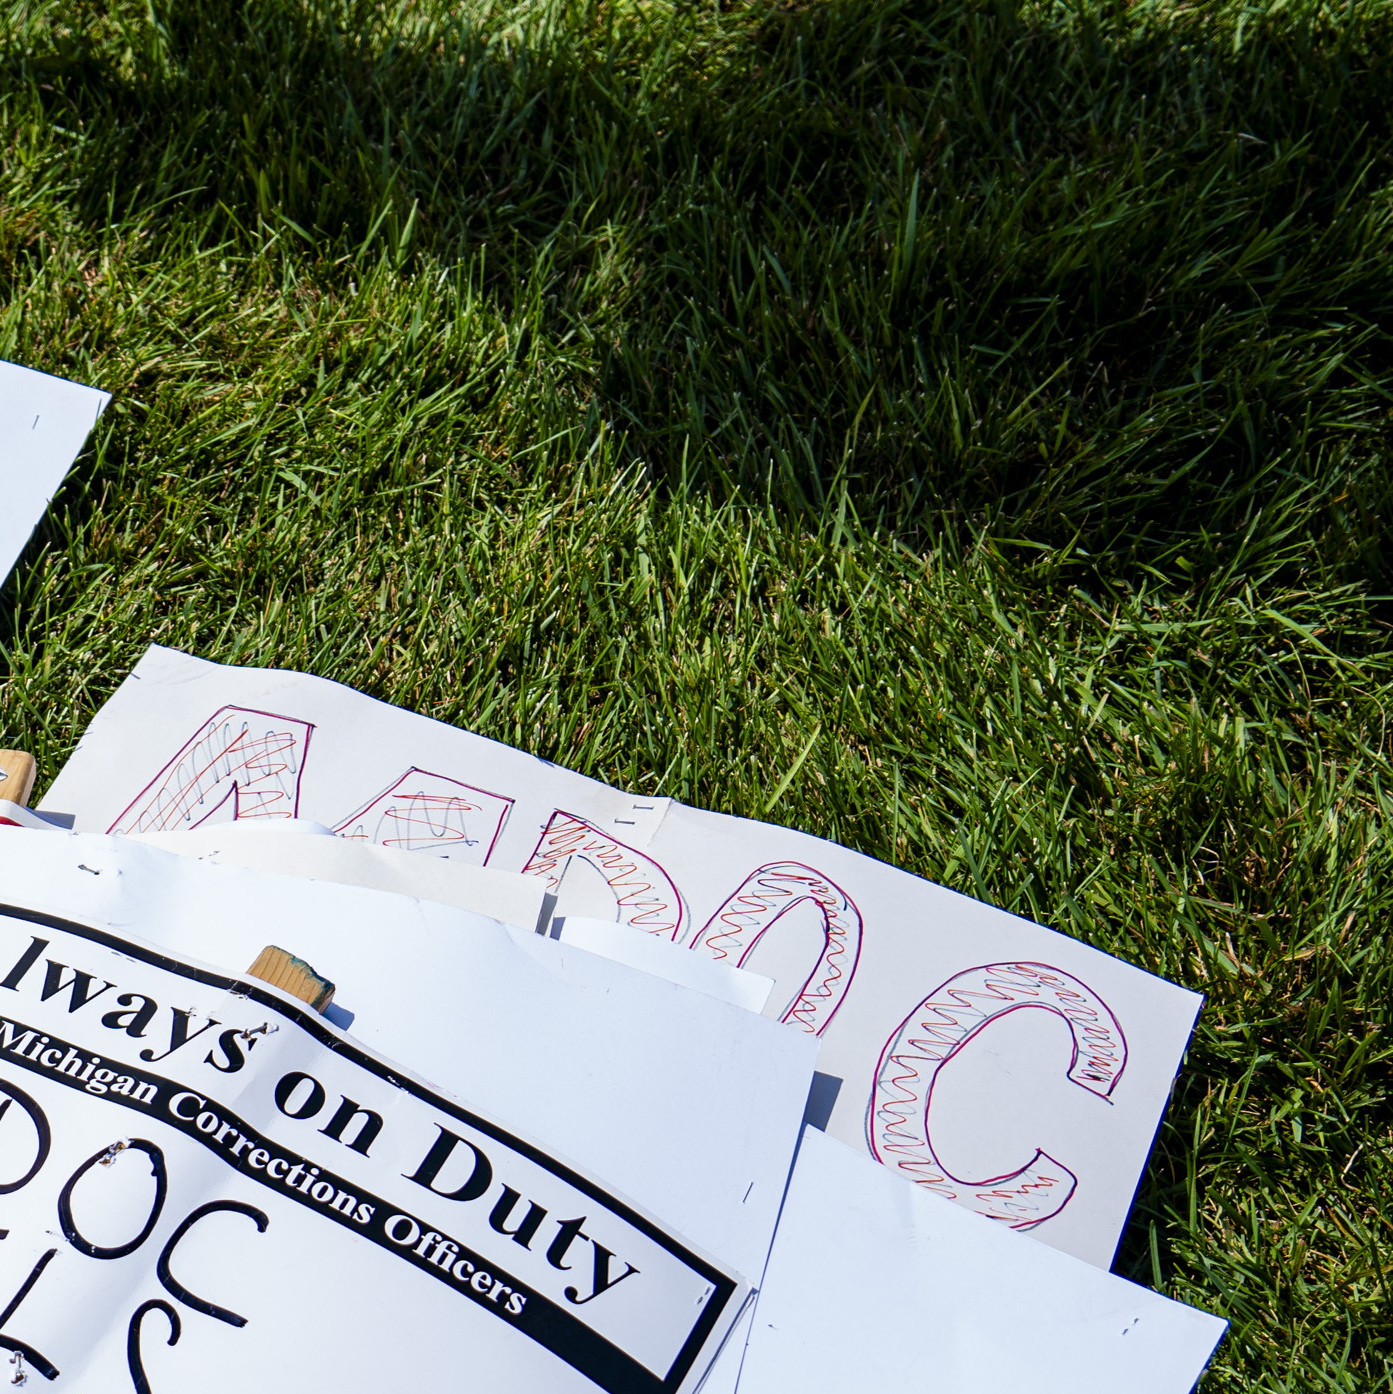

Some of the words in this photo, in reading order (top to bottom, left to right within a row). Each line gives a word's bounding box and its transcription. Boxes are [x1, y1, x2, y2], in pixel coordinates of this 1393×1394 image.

[168, 1090, 376, 1225] Corrections
[383, 1213, 528, 1315] Officers
[273, 1070, 386, 1158] on
[400, 1121, 641, 1305] Duty
